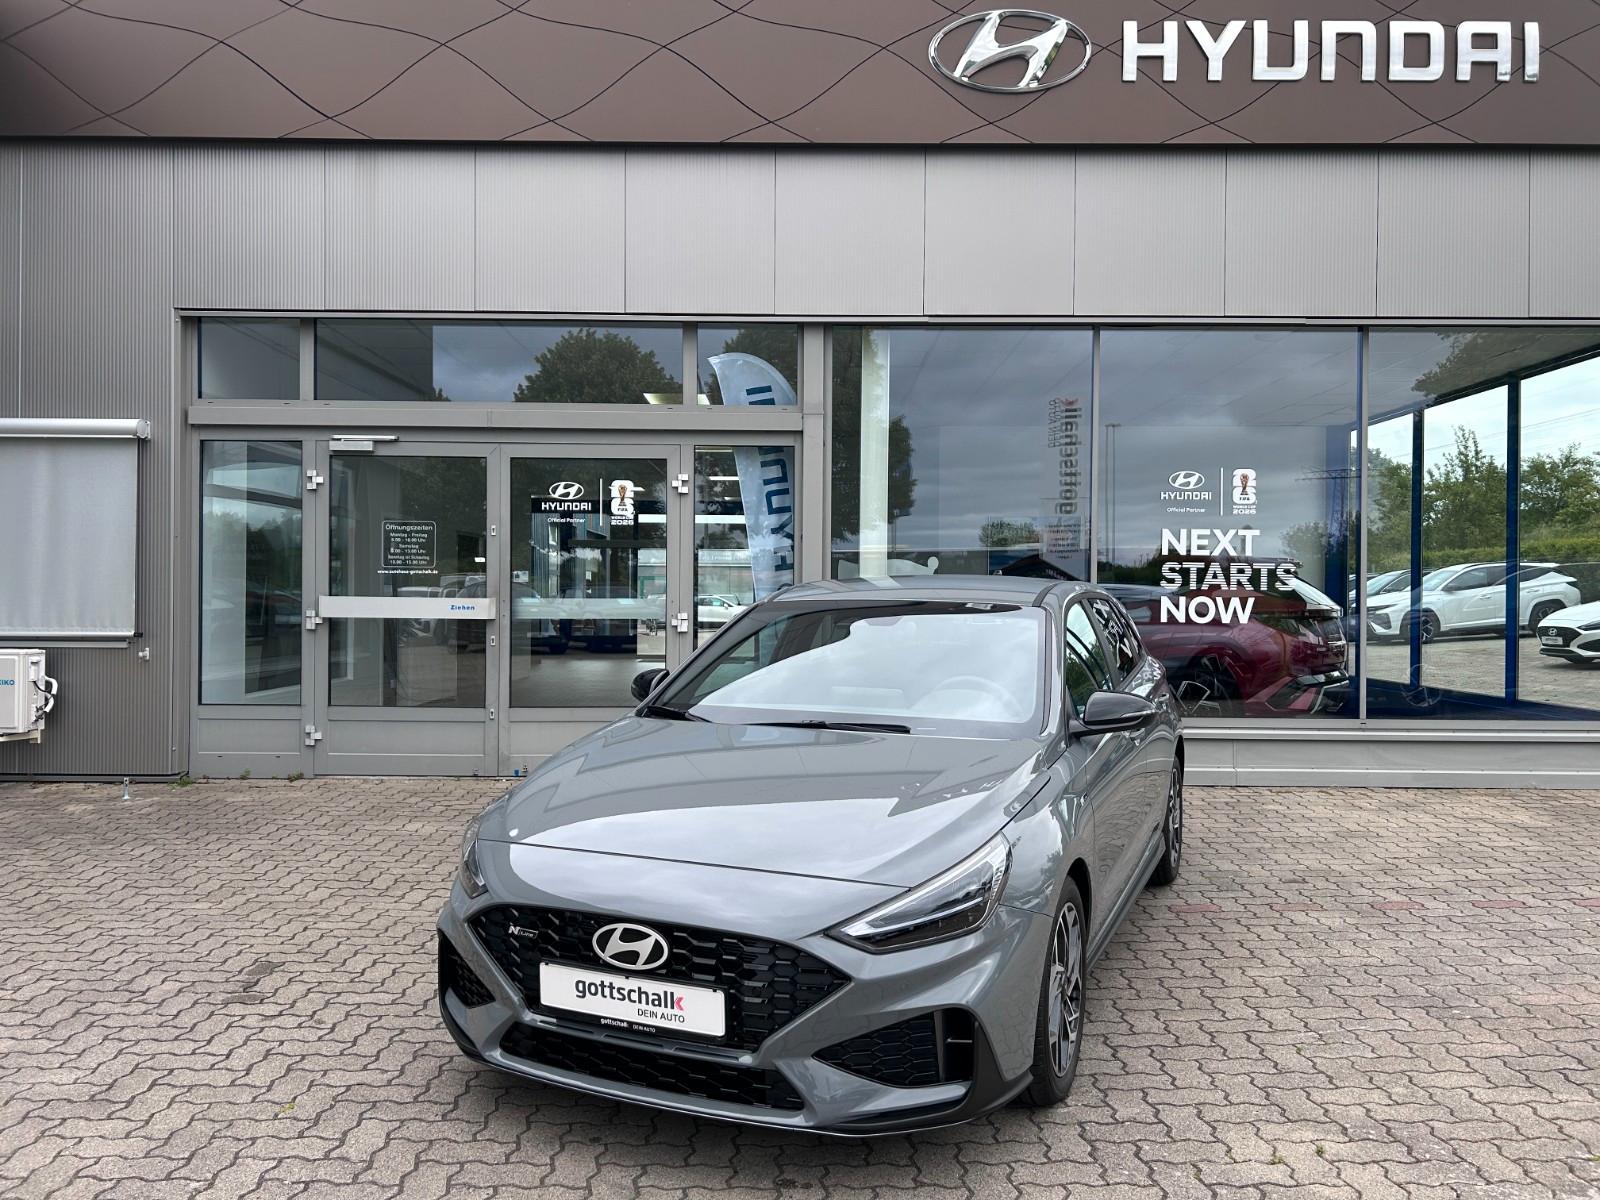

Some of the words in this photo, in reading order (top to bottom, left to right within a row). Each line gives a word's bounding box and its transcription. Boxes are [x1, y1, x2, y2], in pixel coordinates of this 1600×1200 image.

[1122, 20, 1540, 82] HYUNDAI
[541, 502, 592, 511] HYUNDAI
[1160, 491, 1212, 501] HYUNDAI
[1161, 528, 1260, 556] NEXT
[1160, 562, 1297, 591] STARTS
[1160, 596, 1255, 624] NOW
[575, 979, 684, 1011] gottschalk
[637, 1008, 658, 1020] DEIN
[660, 1012, 685, 1024] AUTO
